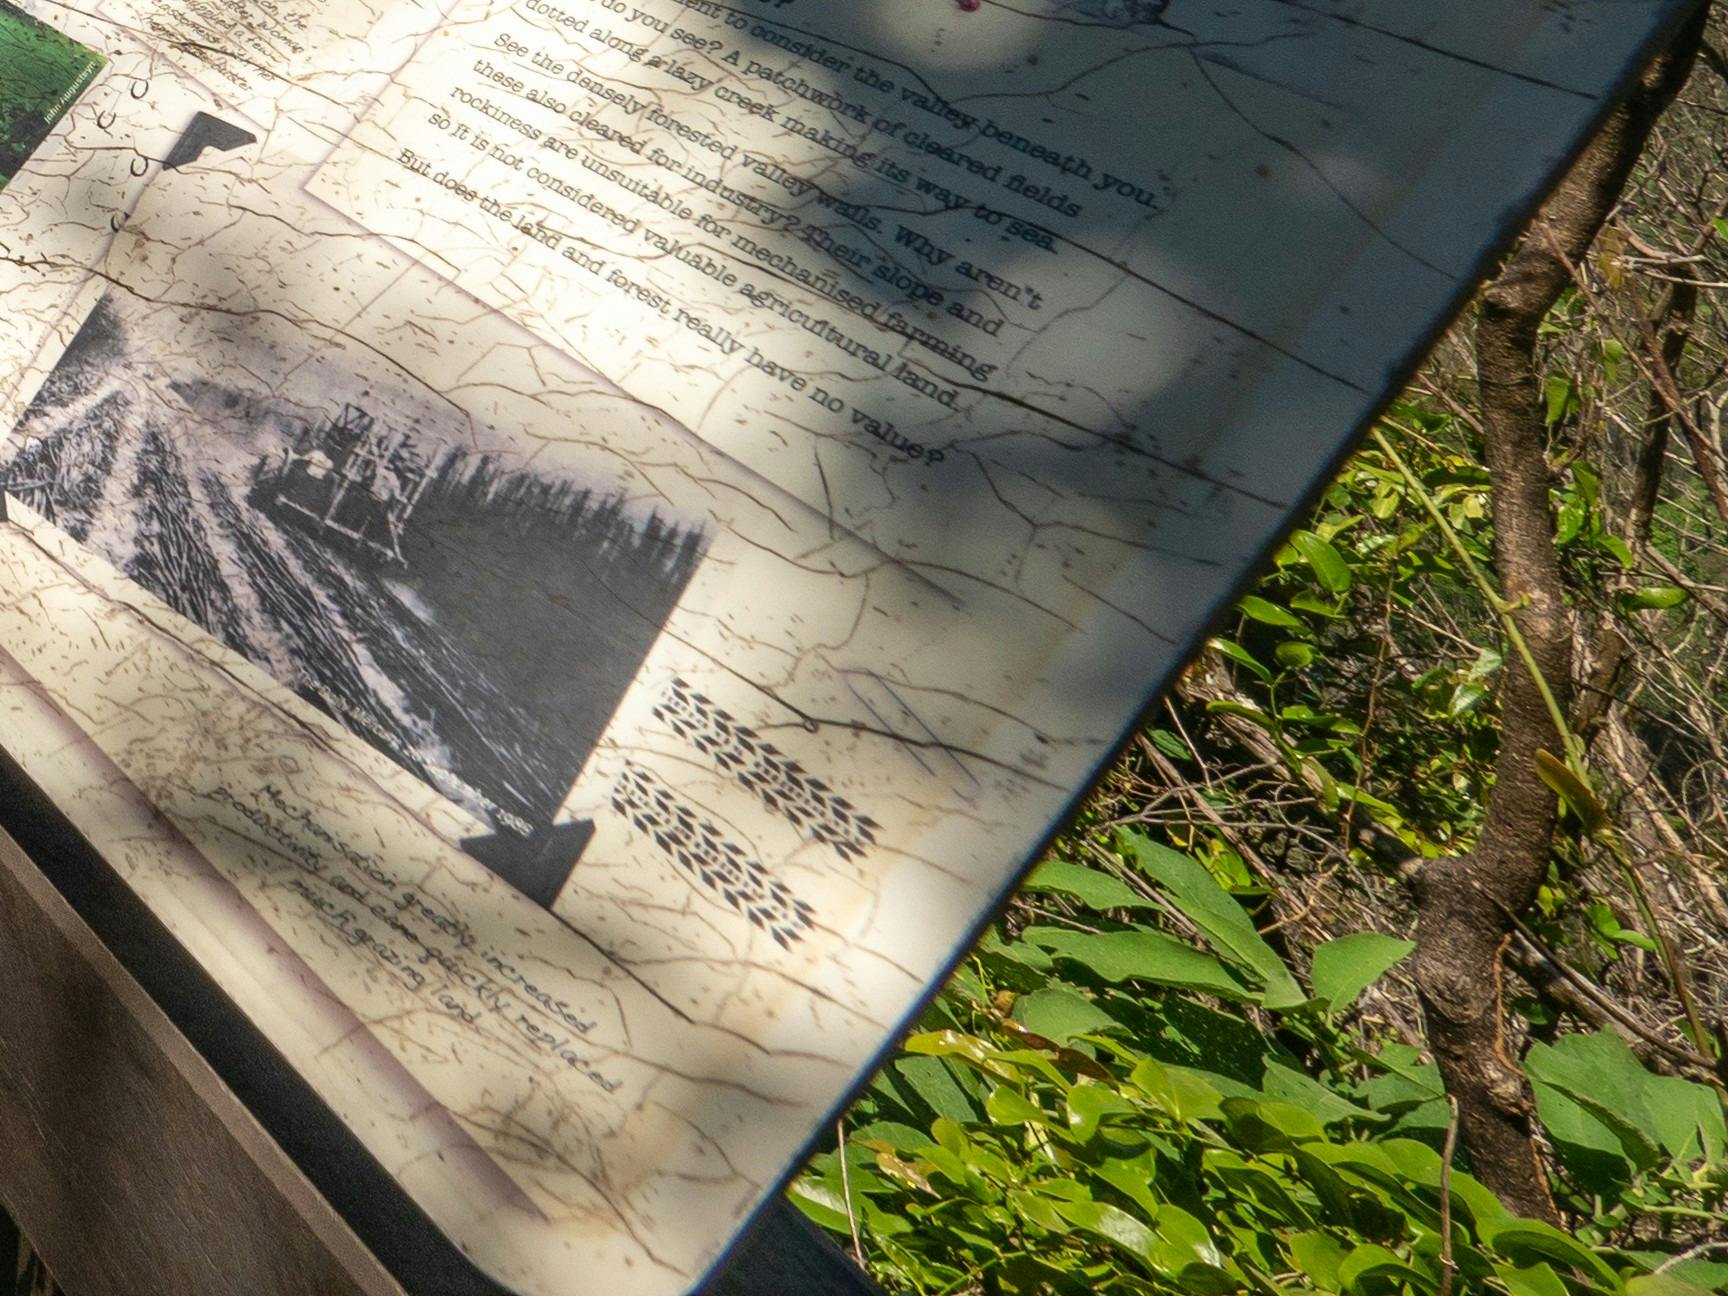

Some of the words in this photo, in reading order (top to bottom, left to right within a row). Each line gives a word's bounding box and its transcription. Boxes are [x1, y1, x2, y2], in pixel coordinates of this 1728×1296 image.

[44, 106, 62, 124] John
[59, 61, 97, 109] Augusteyn
[283, 10, 308, 30] the
[589, 29, 647, 64] along
[649, 56, 663, 68] a
[664, 61, 713, 95] lazy
[714, 86, 783, 122] creek
[779, 117, 878, 171] making
[876, 159, 908, 182] its
[913, 177, 970, 214] way
[972, 205, 1002, 226] to
[1006, 221, 1058, 254] sea.
[624, 8, 669, 32] you
[671, 29, 724, 56] see?
[722, 47, 745, 66] A
[739, 61, 873, 123] patchwork
[874, 119, 907, 138] of
[901, 131, 1003, 182] cleared
[1003, 175, 1080, 219] fields
[723, 13, 746, 30] to
[751, 26, 849, 74] consider
[851, 68, 894, 94] the
[895, 87, 976, 133] valley
[978, 122, 1098, 181] beneath
[1093, 173, 1158, 210] you.
[428, 114, 450, 131] so
[450, 124, 471, 141] it
[469, 135, 488, 152] is
[489, 148, 526, 171] not
[526, 167, 641, 233] considered
[641, 228, 736, 287] valuable
[740, 283, 894, 372] agricultural
[892, 365, 960, 412] land.
[449, 88, 540, 141] rockiness
[543, 137, 578, 160] are
[579, 156, 692, 220] unsuitable
[694, 214, 730, 240] for
[732, 236, 892, 323] mechanised
[883, 313, 998, 384] farming
[472, 61, 523, 93] these
[526, 89, 564, 114] also
[568, 111, 649, 155] cleared
[645, 148, 681, 173] for
[682, 166, 802, 233] industry?
[799, 223, 869, 269] Their
[873, 265, 945, 308] slope
[947, 302, 1006, 337] and
[493, 34, 528, 58] See
[530, 53, 563, 75] the
[566, 69, 647, 119] densely
[644, 107, 739, 159] forested
[738, 153, 822, 205] valley
[814, 191, 882, 233] walls.
[891, 224, 954, 270] Why
[955, 260, 1046, 310] aren't
[397, 148, 434, 176] But
[433, 170, 476, 202] does
[478, 198, 511, 222] the
[514, 217, 563, 250] land
[562, 246, 607, 275] and
[604, 269, 675, 315] forest
[672, 310, 744, 360] really
[745, 349, 806, 392] have
[809, 388, 844, 414] no
[847, 408, 946, 470] value?
[211, 783, 329, 879] productivity
[331, 871, 372, 904] and
[371, 901, 421, 945] cane
[422, 944, 512, 1019] quickly
[515, 1013, 624, 1097] replaced
[257, 779, 397, 892] Mechanisation
[398, 891, 478, 956] greatly
[478, 945, 597, 1037] increased
[288, 875, 357, 930] much
[347, 924, 428, 994] grazing
